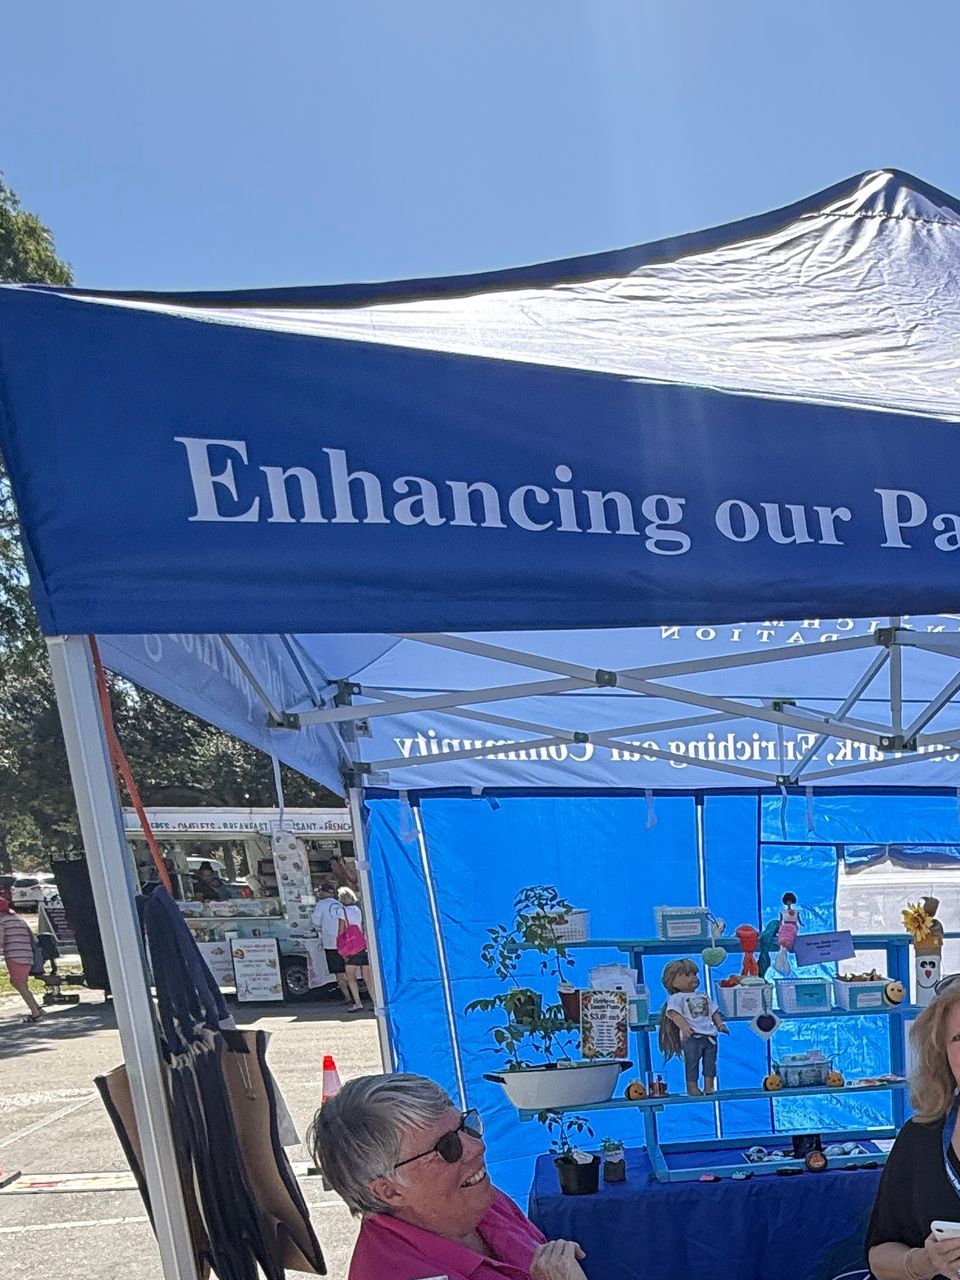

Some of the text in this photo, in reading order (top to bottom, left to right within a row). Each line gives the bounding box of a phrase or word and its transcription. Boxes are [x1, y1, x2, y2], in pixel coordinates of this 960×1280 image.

[173, 434, 694, 556] Enhancing
[715, 495, 853, 546] our
[222, 822, 268, 831] BREAKFAST
